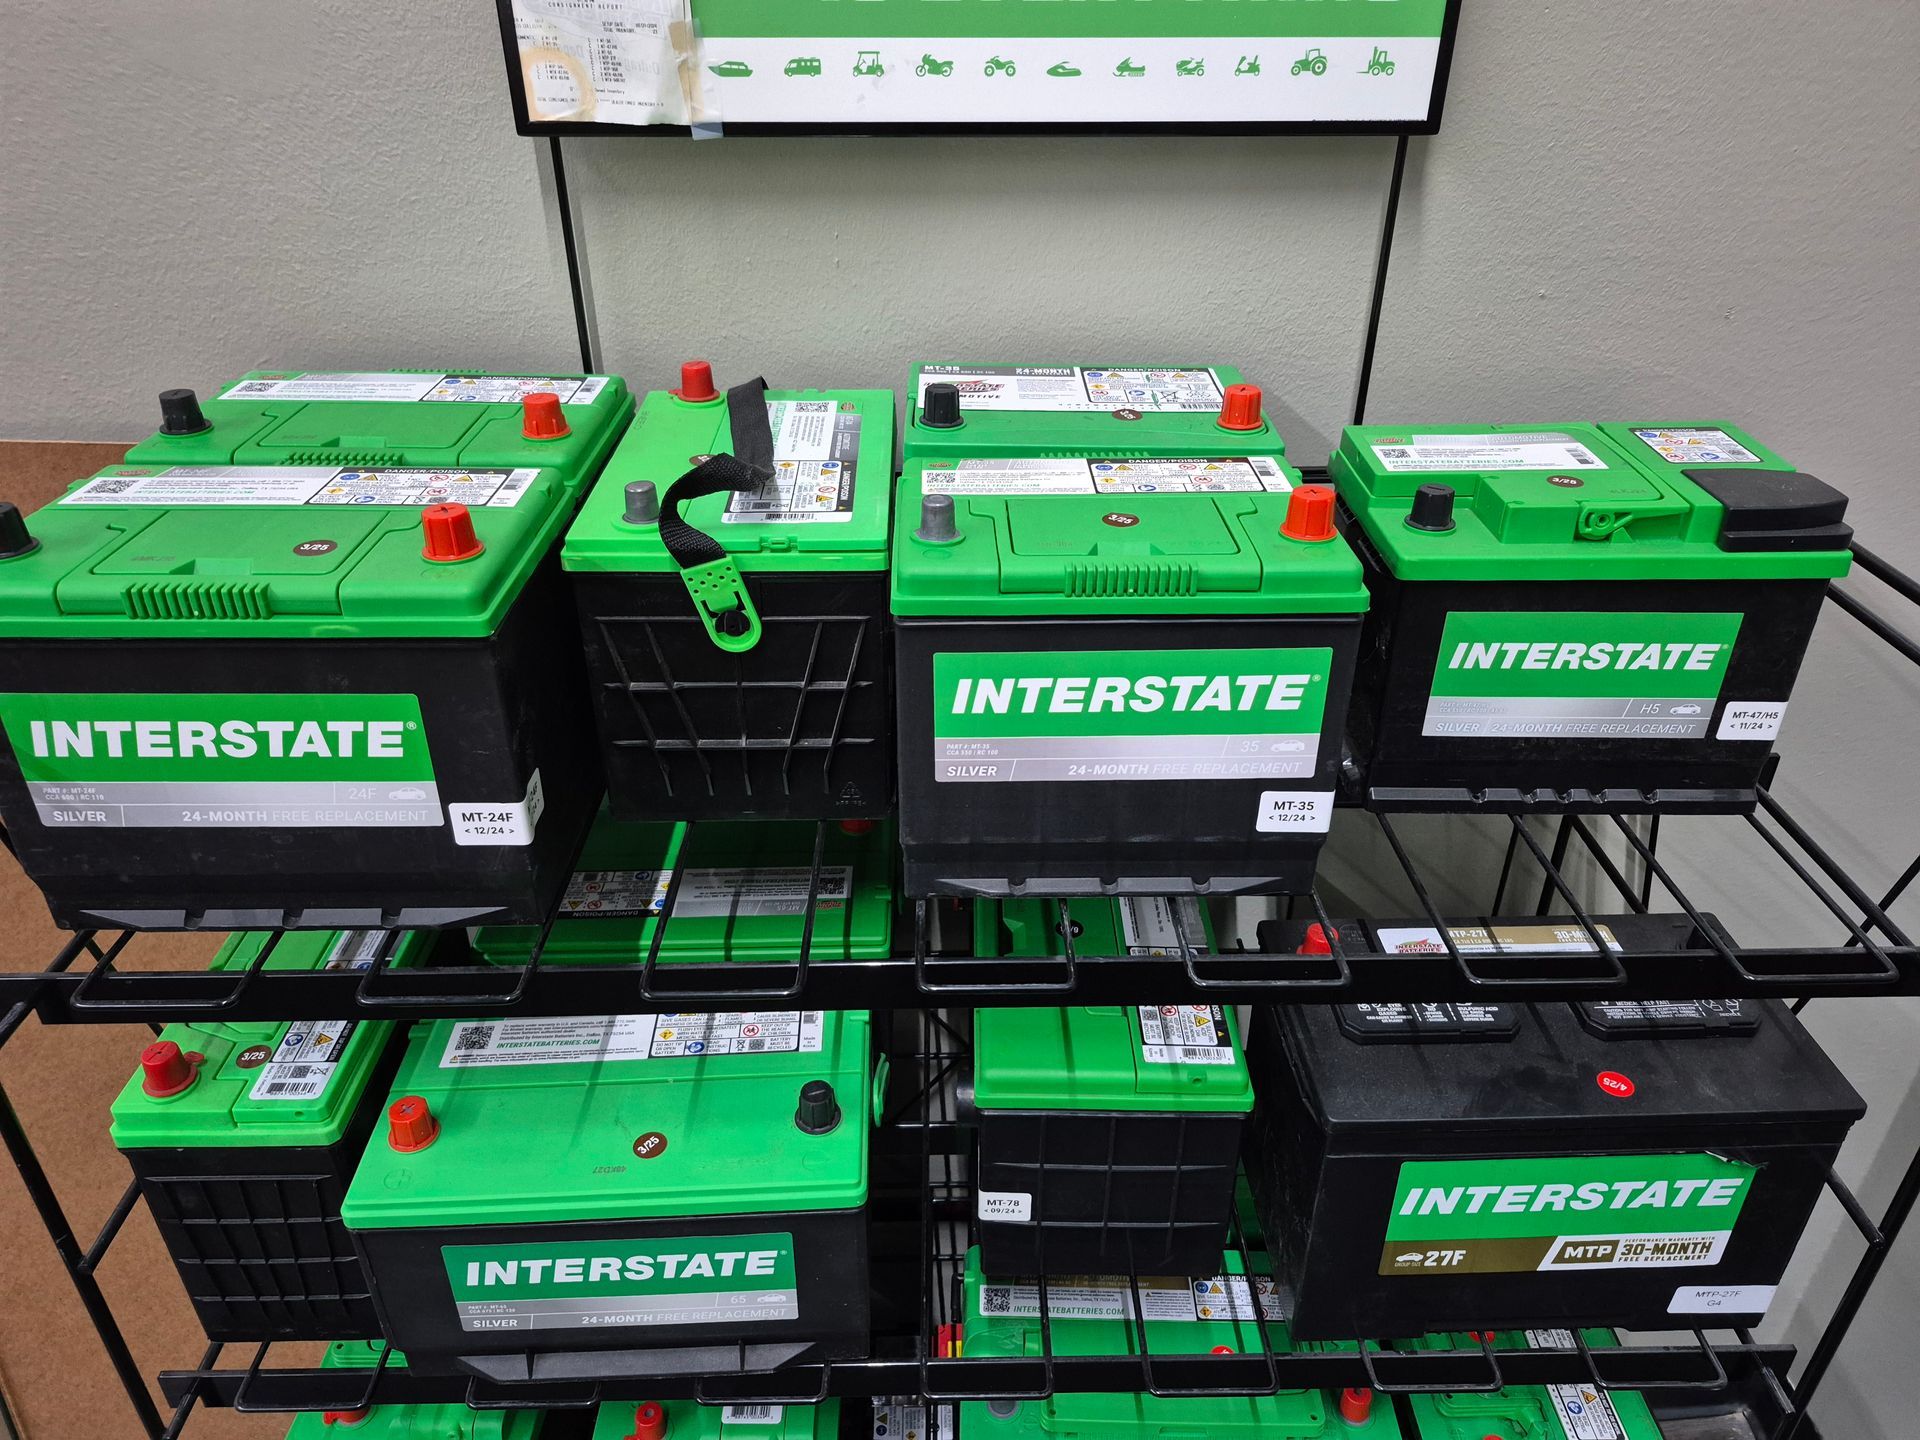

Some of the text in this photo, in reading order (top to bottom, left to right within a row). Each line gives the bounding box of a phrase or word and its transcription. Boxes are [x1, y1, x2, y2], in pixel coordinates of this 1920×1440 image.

[300, 543, 329, 552] 3/25
[1448, 642, 1721, 670] INTERSTATE
[1640, 704, 1661, 714] H5
[1732, 711, 1779, 719] MT-47/H5
[1435, 722, 1696, 734] SILVER 24-MONTH FREE REPLACEMENT
[1739, 722, 1763, 730] 11/24
[1240, 741, 1260, 752] 35
[947, 762, 1303, 777] SILVER 24-MONTH FREE REPLACEMENT
[348, 788, 377, 799] 24F
[1273, 801, 1315, 811] MT-35
[53, 810, 428, 822] SILVER 24-MONTH FREE REPLACEMENT
[462, 812, 513, 823] MT-24F
[1278, 814, 1306, 822] 12/24
[474, 826, 505, 835] 12/24
[496, 1039, 600, 1049] INTERSTATEBATTERIES.COM
[241, 1051, 265, 1061] 3/25
[1603, 1077, 1628, 1091] 4/25
[637, 1135, 660, 1154] 3/25
[1399, 1177, 1745, 1216] INTERSTATE
[987, 1199, 1020, 1207] MT-78
[1563, 1241, 1713, 1259] MTP 30-MONTH
[1424, 1250, 1467, 1267] 27F
[1644, 1254, 1708, 1262] REPLACEMENT
[466, 1249, 778, 1286] INTERSTATE
[730, 1294, 746, 1305] 65
[1695, 1290, 1741, 1298] MTP-27F
[1707, 1299, 1722, 1307] G4
[1013, 1305, 1125, 1315] INTERSATEBATTERIES.COM
[473, 1308, 787, 1328] SILVER 24-MONTH FREE REPLACEMENT
